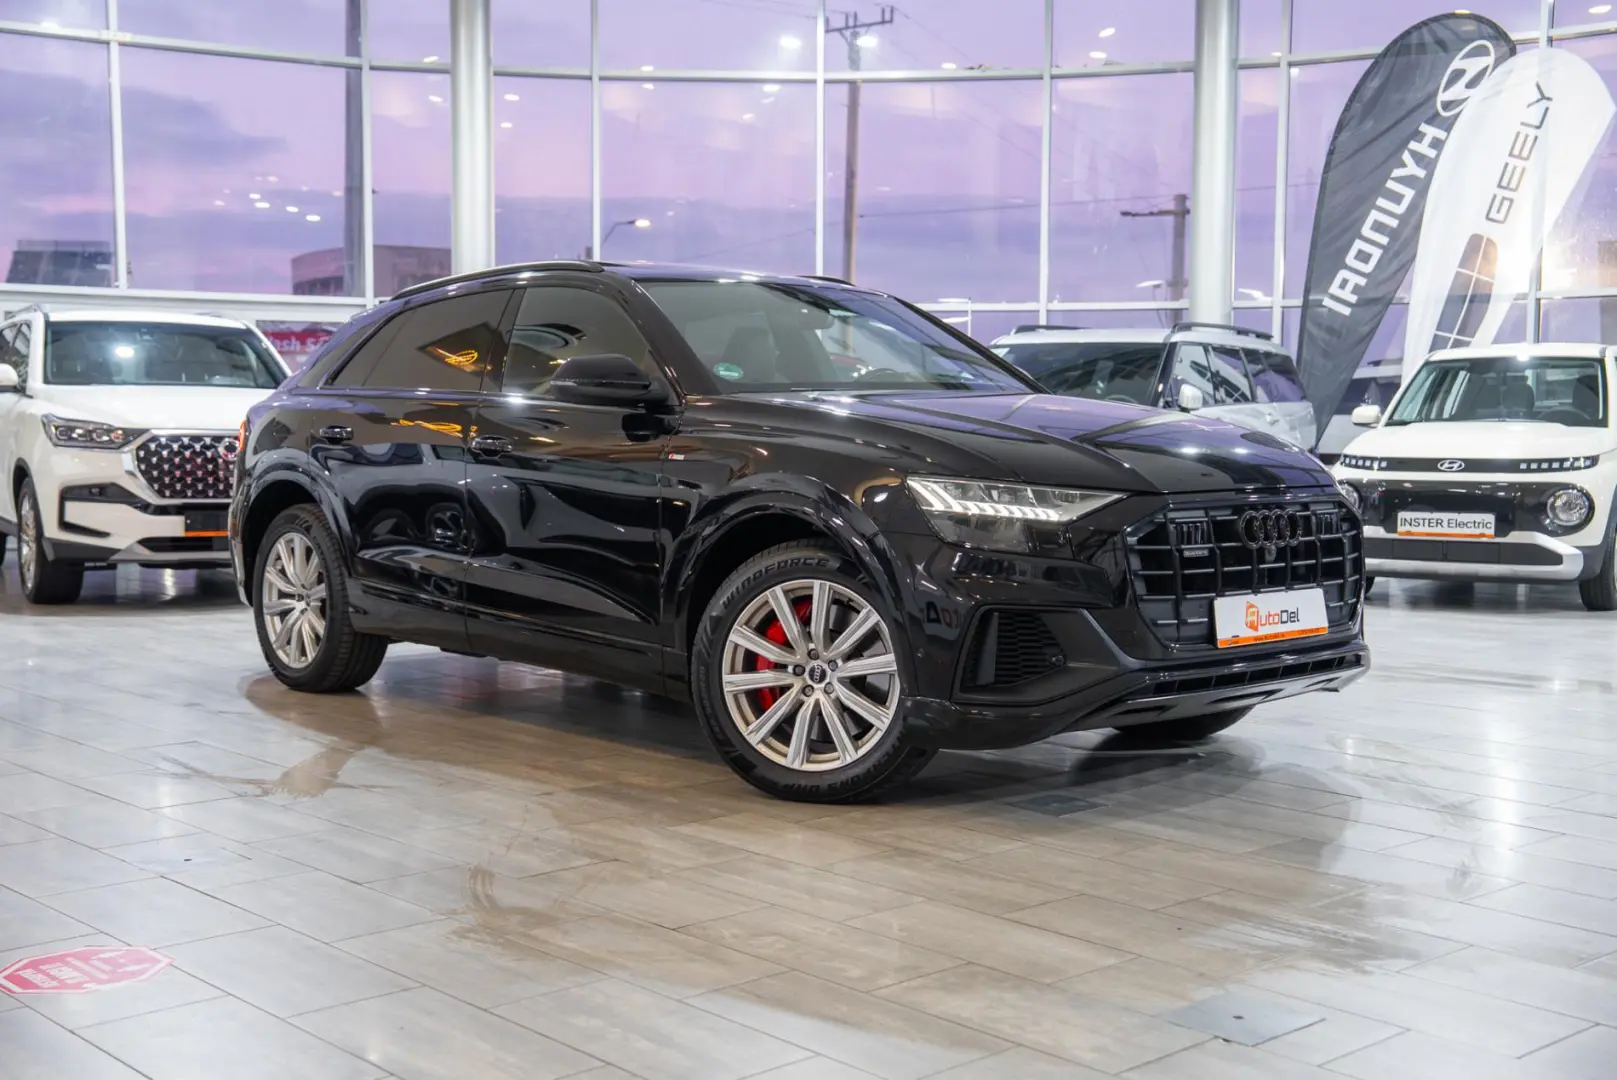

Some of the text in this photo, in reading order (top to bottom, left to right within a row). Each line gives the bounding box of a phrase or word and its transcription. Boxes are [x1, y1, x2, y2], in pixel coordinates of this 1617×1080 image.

[1484, 81, 1553, 224] GEELY
[1400, 517, 1493, 530] INSTER Electric
[721, 557, 831, 610] WINDFORCE
[1245, 600, 1300, 632] AutoDel
